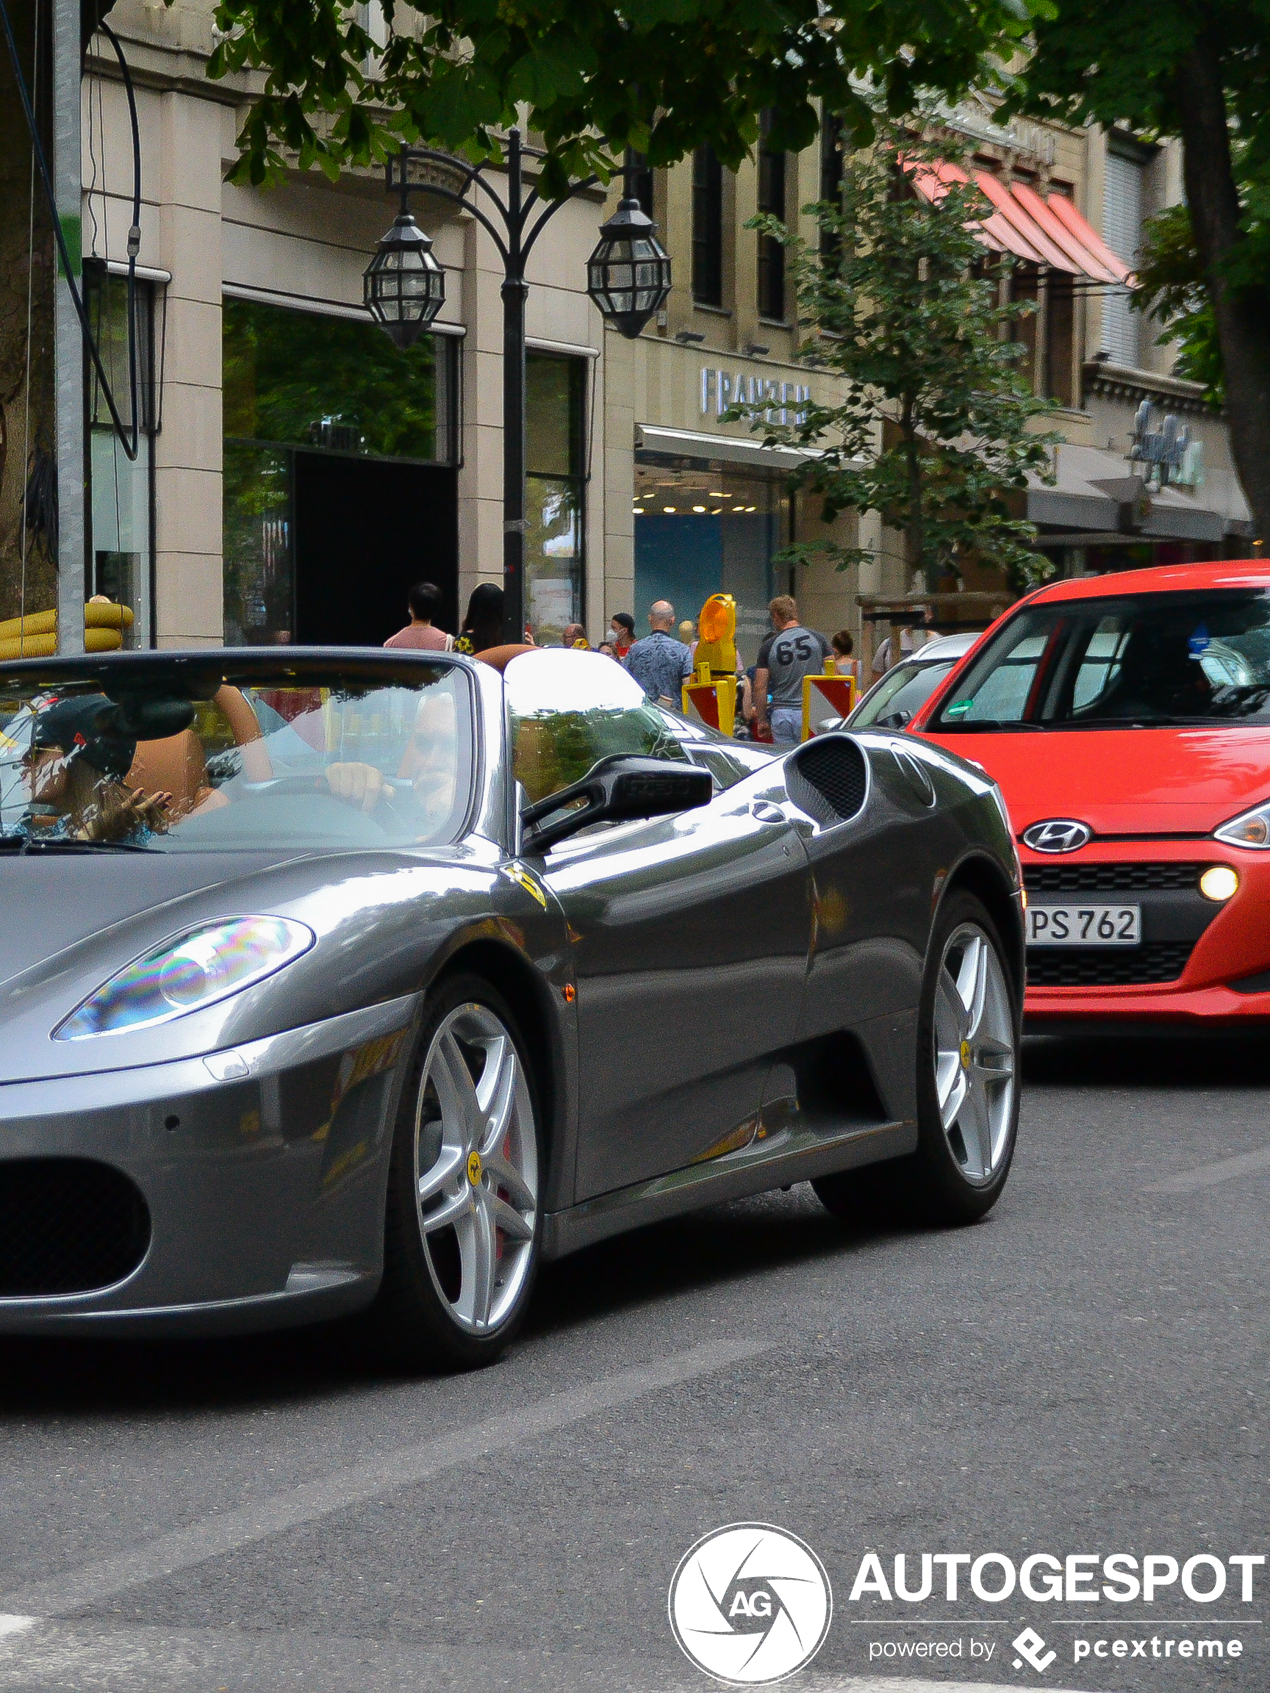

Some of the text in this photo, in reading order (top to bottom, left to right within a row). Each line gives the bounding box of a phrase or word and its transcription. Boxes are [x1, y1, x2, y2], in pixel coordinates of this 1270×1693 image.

[776, 634, 811, 666] 65
[1030, 910, 1135, 939] PS 762
